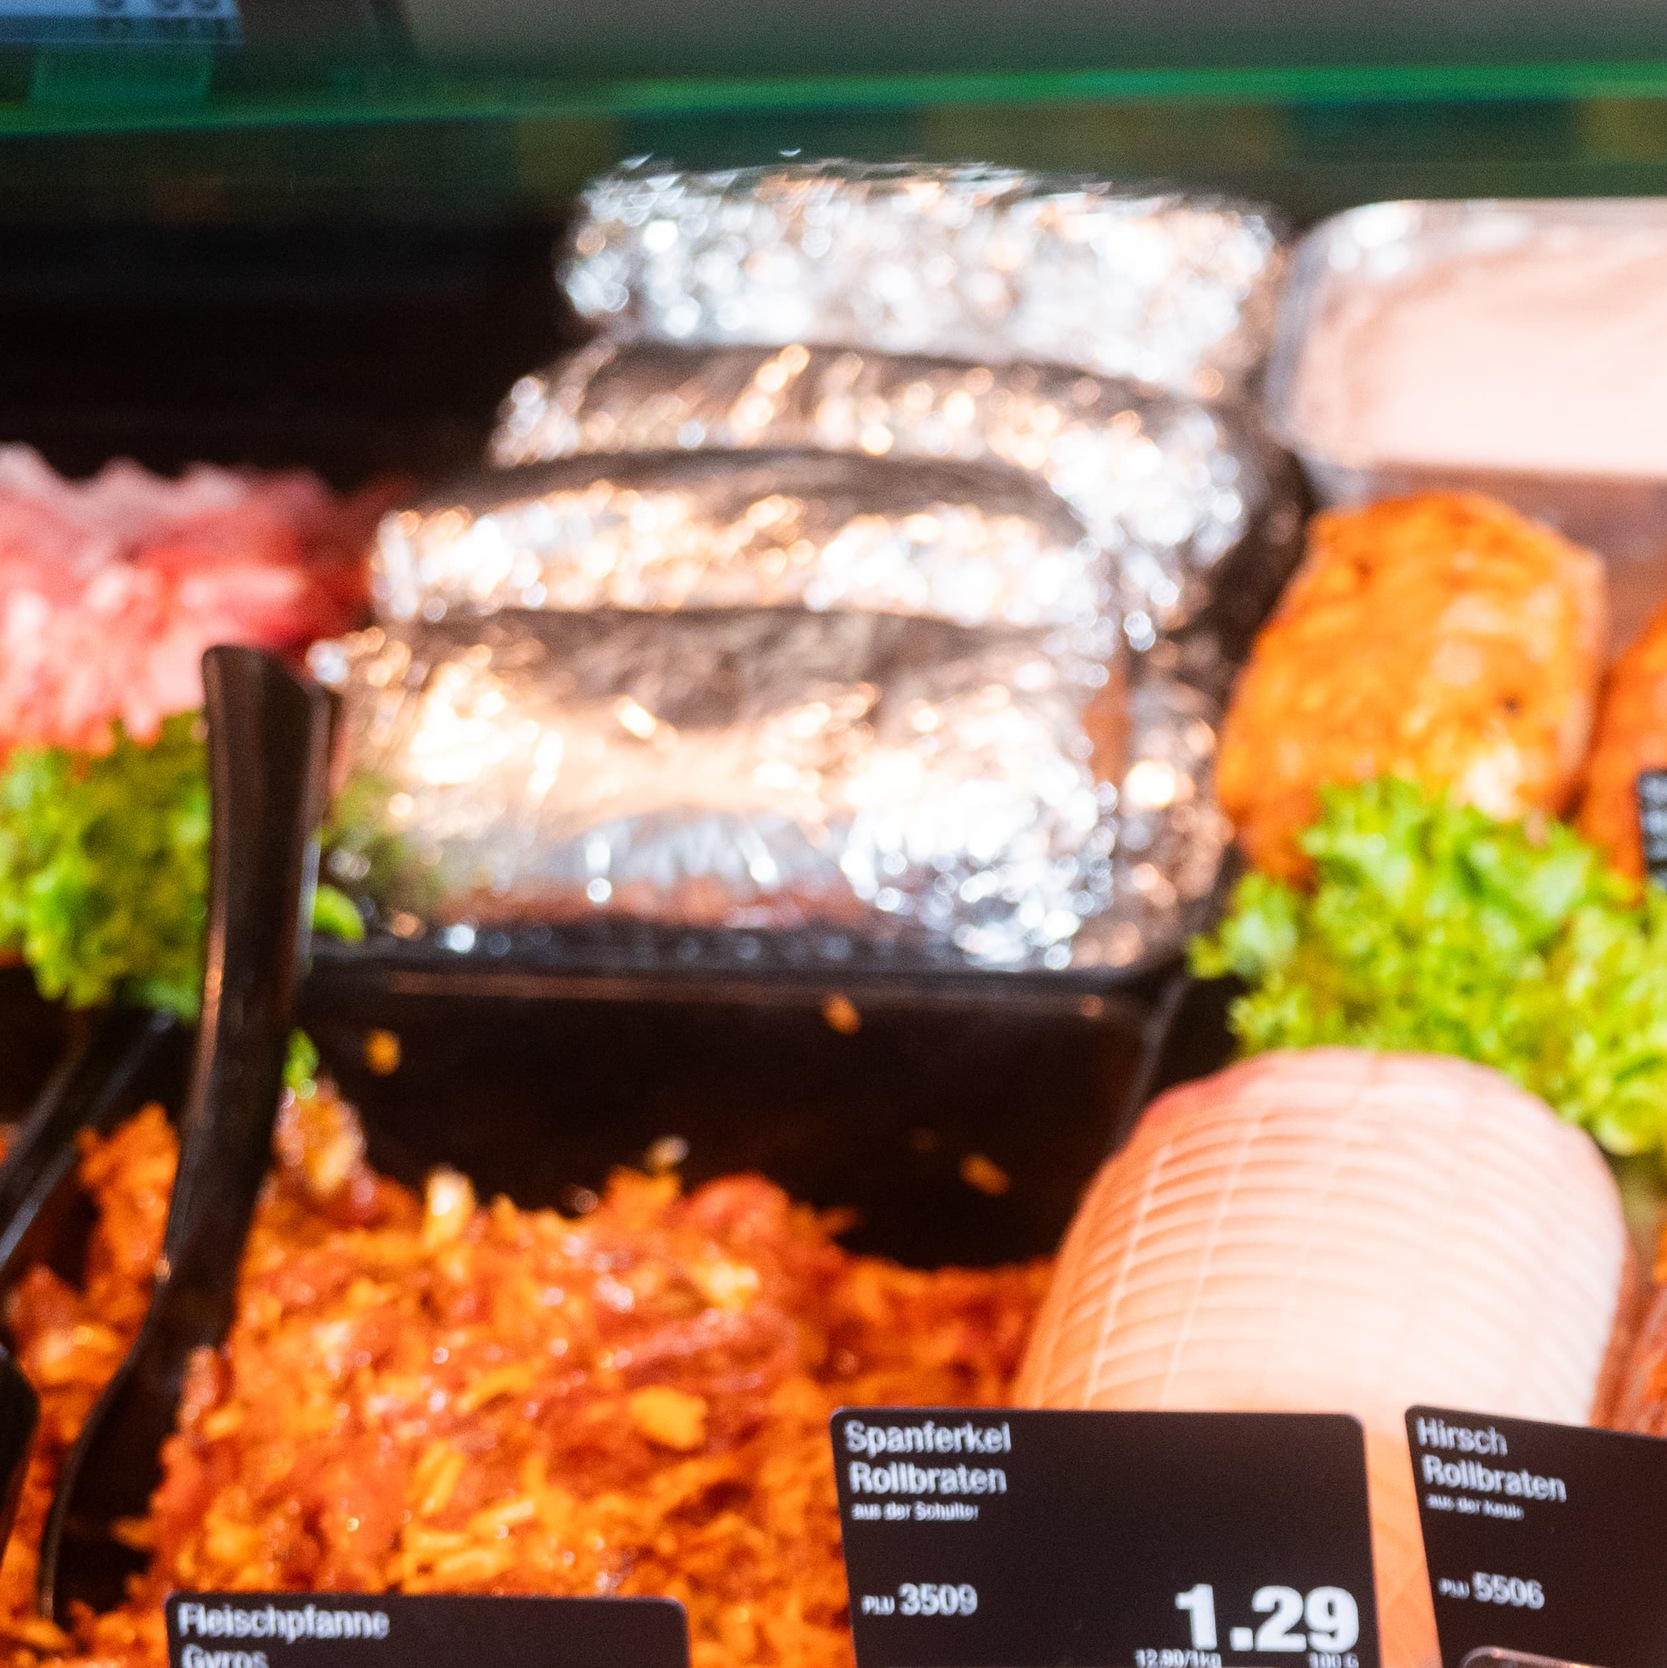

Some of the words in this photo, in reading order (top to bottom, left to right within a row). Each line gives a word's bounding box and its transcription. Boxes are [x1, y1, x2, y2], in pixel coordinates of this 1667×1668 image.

[845, 1419, 1012, 1458] Spanferkel
[1416, 1416, 1508, 1457] Hirsch
[850, 1460, 1008, 1495] Rollbraten
[1422, 1453, 1567, 1503] Rollbraten
[861, 1595, 895, 1616] PLU
[899, 1583, 978, 1616] 3509
[1472, 1572, 1545, 1610] 5506
[178, 1603, 390, 1645] Fleischpfanne
[1175, 1583, 1359, 1653] 1.29
